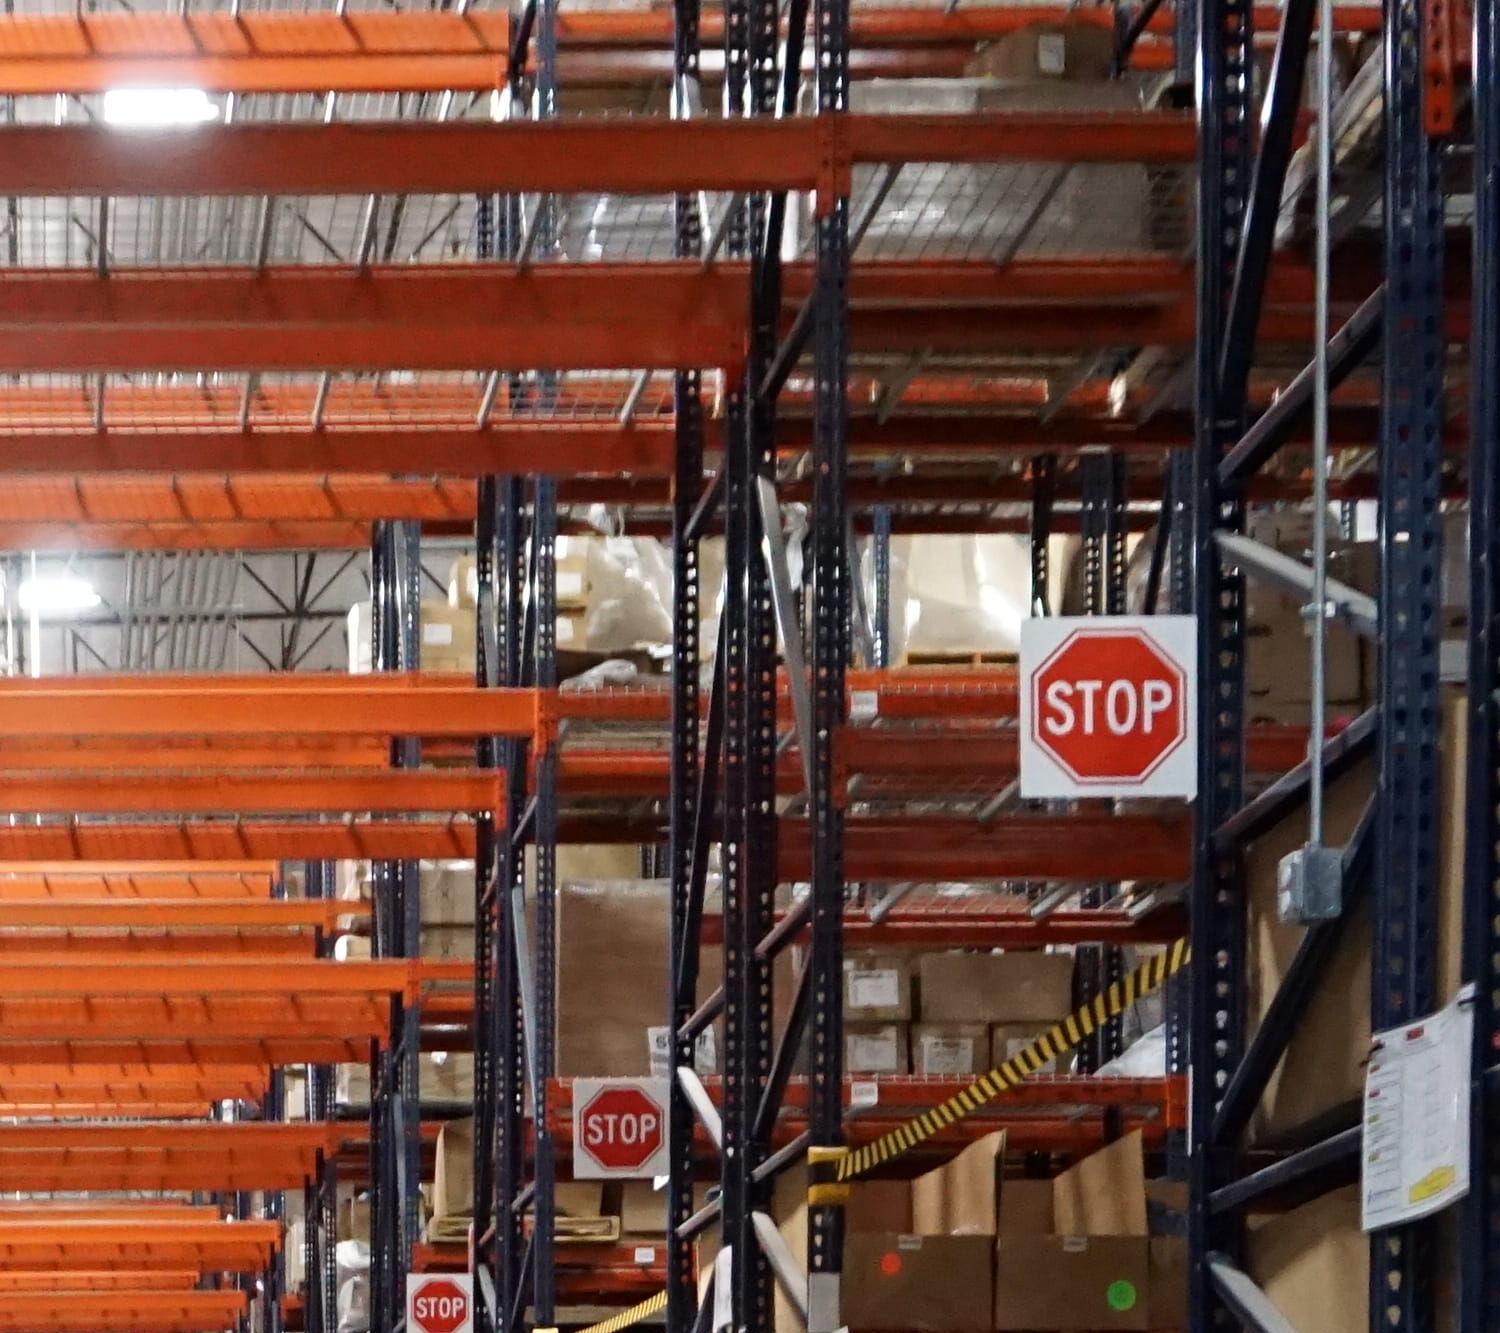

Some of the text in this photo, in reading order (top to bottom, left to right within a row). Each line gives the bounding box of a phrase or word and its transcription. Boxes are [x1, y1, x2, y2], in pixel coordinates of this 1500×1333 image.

[1045, 680, 1173, 735] STOP
[587, 1113, 656, 1145] STOP
[416, 1297, 463, 1319] STOP
